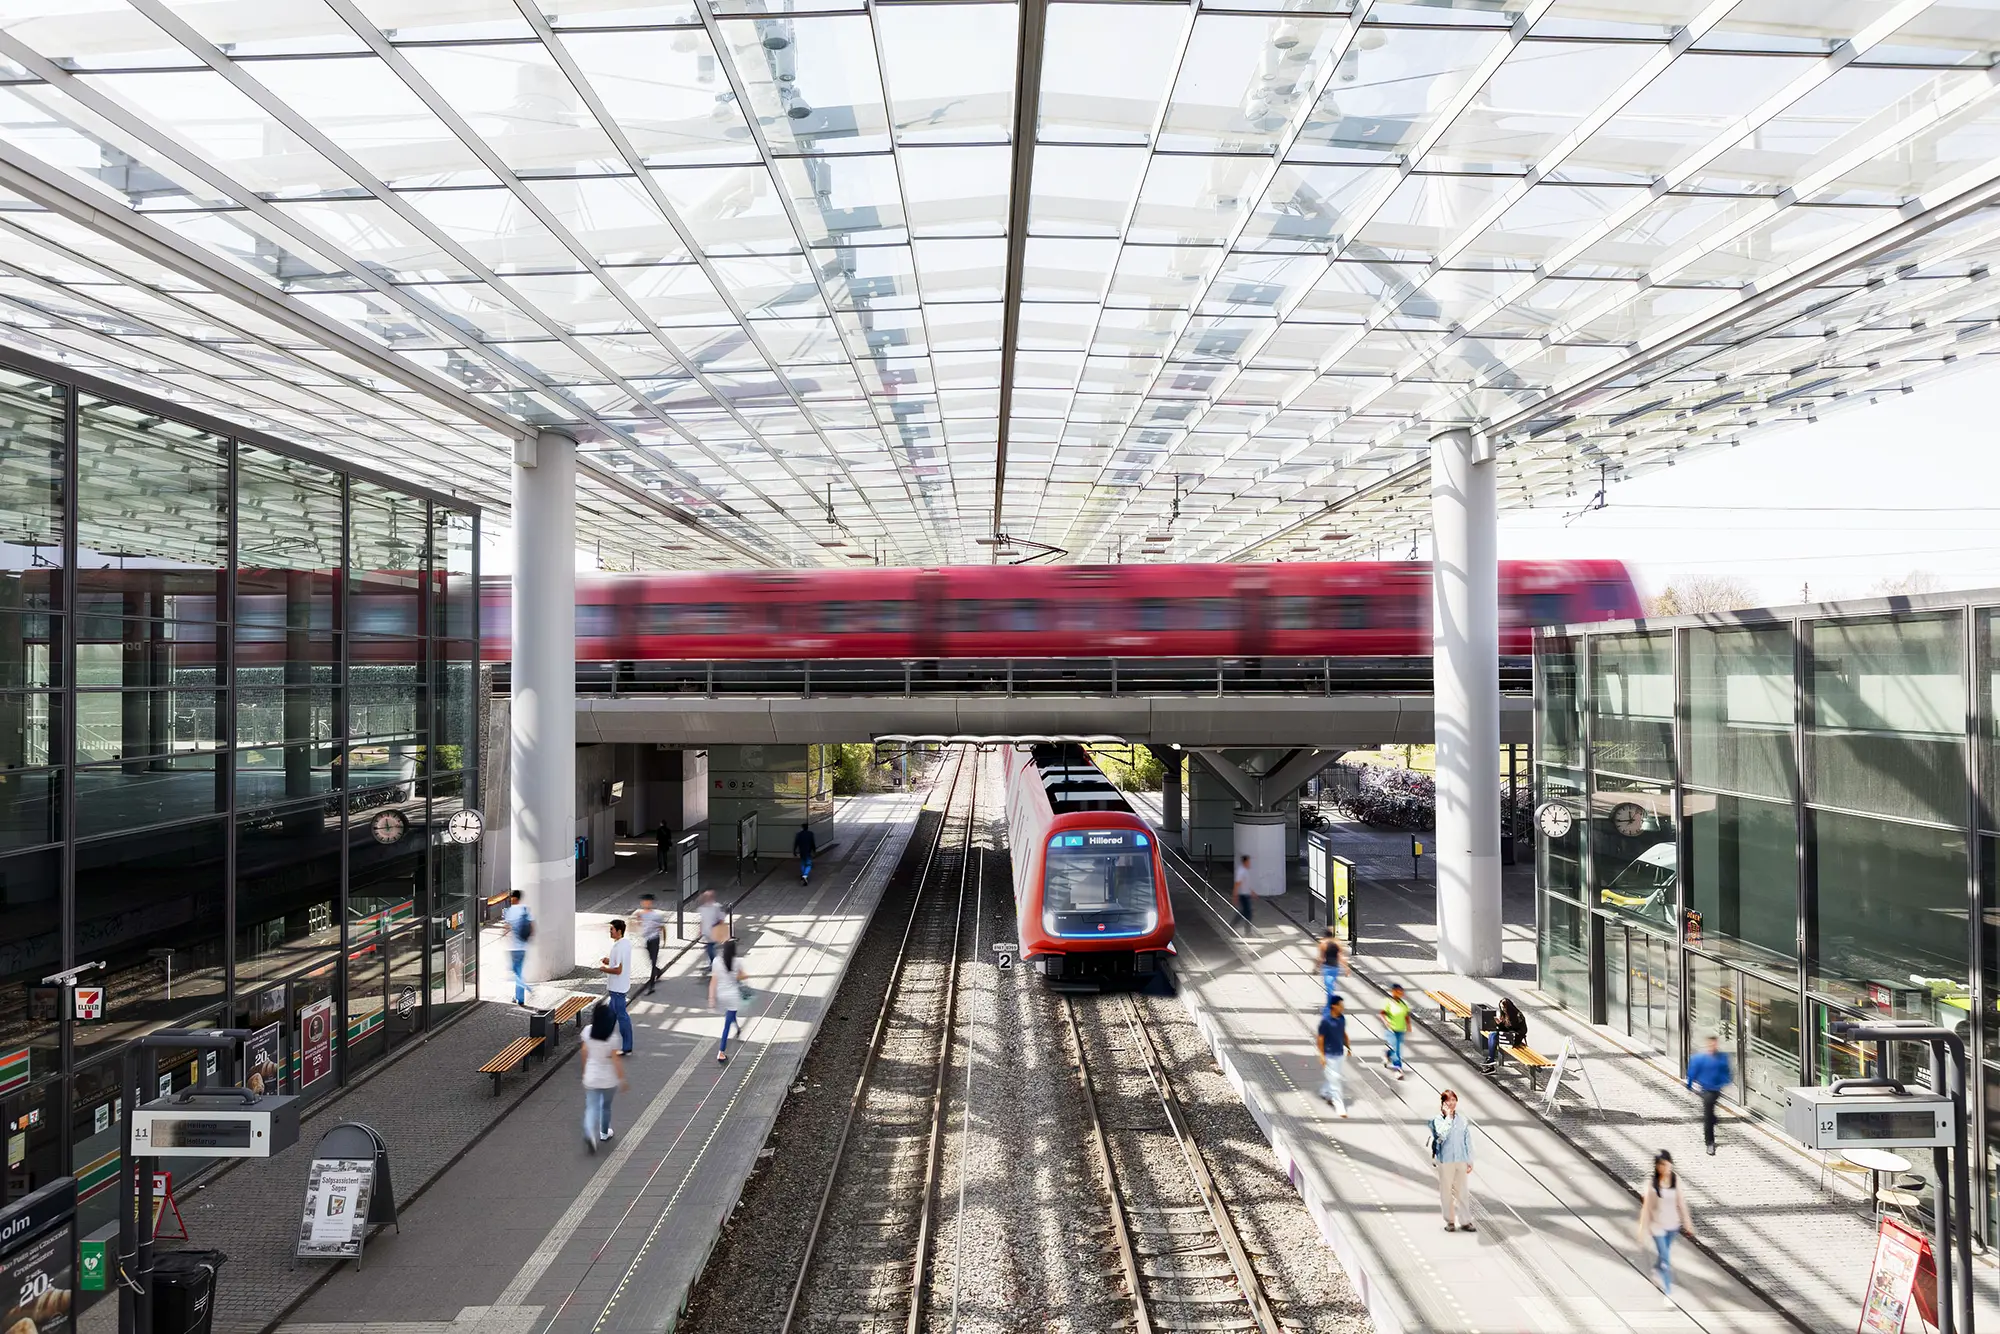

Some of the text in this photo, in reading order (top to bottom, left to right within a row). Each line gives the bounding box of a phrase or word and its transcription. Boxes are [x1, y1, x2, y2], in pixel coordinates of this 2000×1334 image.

[1000, 954, 1011, 969] 2
[1820, 1121, 1834, 1131] 12
[135, 1128, 148, 1137] 11
[0, 1216, 30, 1242] olm
